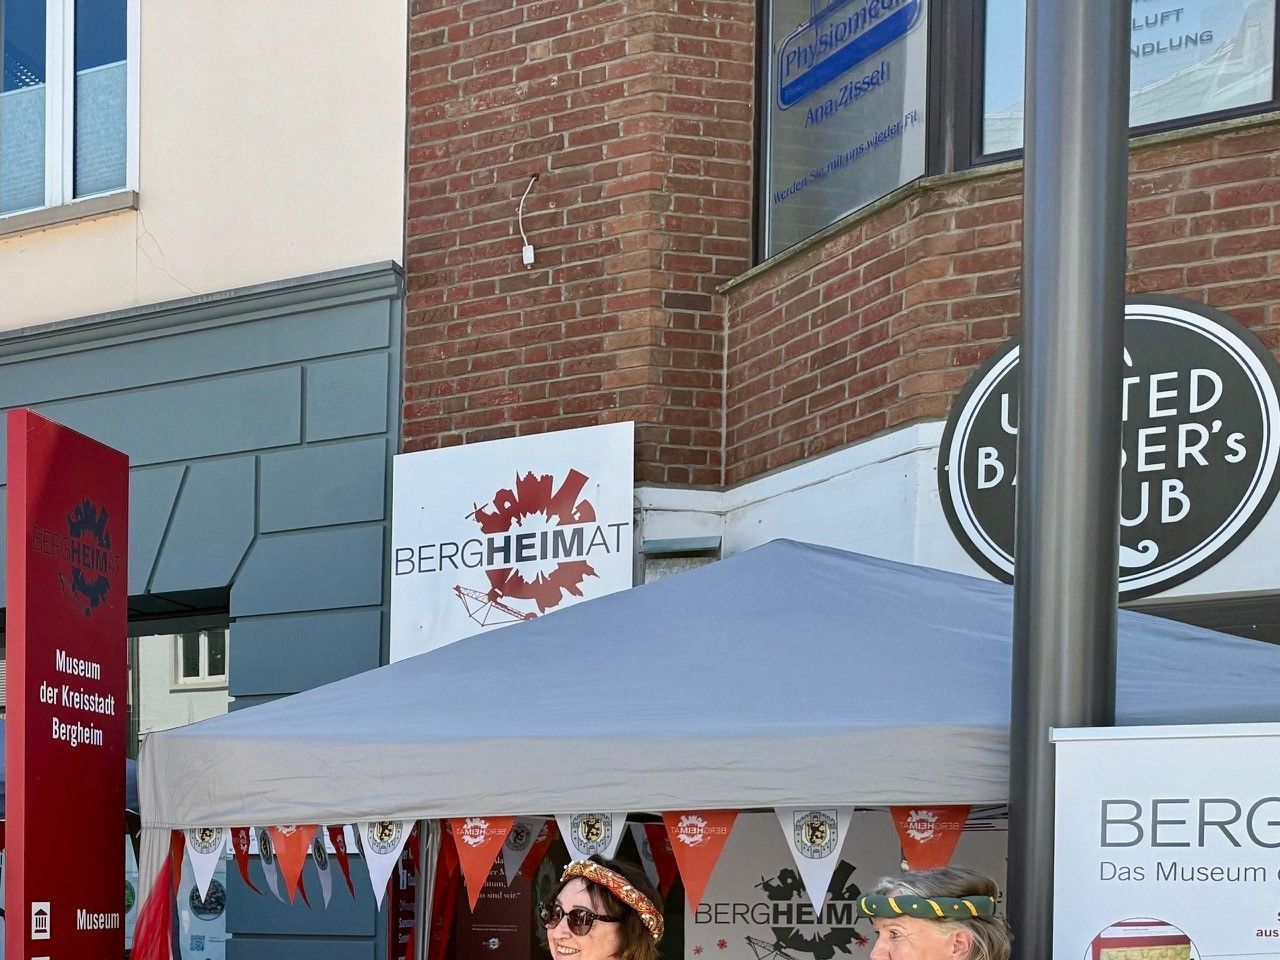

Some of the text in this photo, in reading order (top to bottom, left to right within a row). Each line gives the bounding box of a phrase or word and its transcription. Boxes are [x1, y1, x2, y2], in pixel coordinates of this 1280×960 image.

[1130, 30, 1213, 58] NDLUNG
[805, 61, 886, 129] Ana Zissel
[773, 178, 808, 204] Werden
[866, 121, 902, 149] wieder
[1001, 368, 1223, 435] UTED
[977, 420, 1247, 489] BER's
[1120, 478, 1191, 527] UB
[32, 526, 120, 575] BERGHEIMAT
[395, 522, 629, 576] BERGHEIMAT
[55, 649, 101, 680] Museum
[40, 681, 115, 716] der Kreisstadt
[52, 717, 103, 747] Bergheim
[1100, 861, 1145, 882] Das
[1156, 861, 1267, 882] Museum
[76, 909, 119, 930] Museum
[694, 903, 873, 925] BERGHEM
